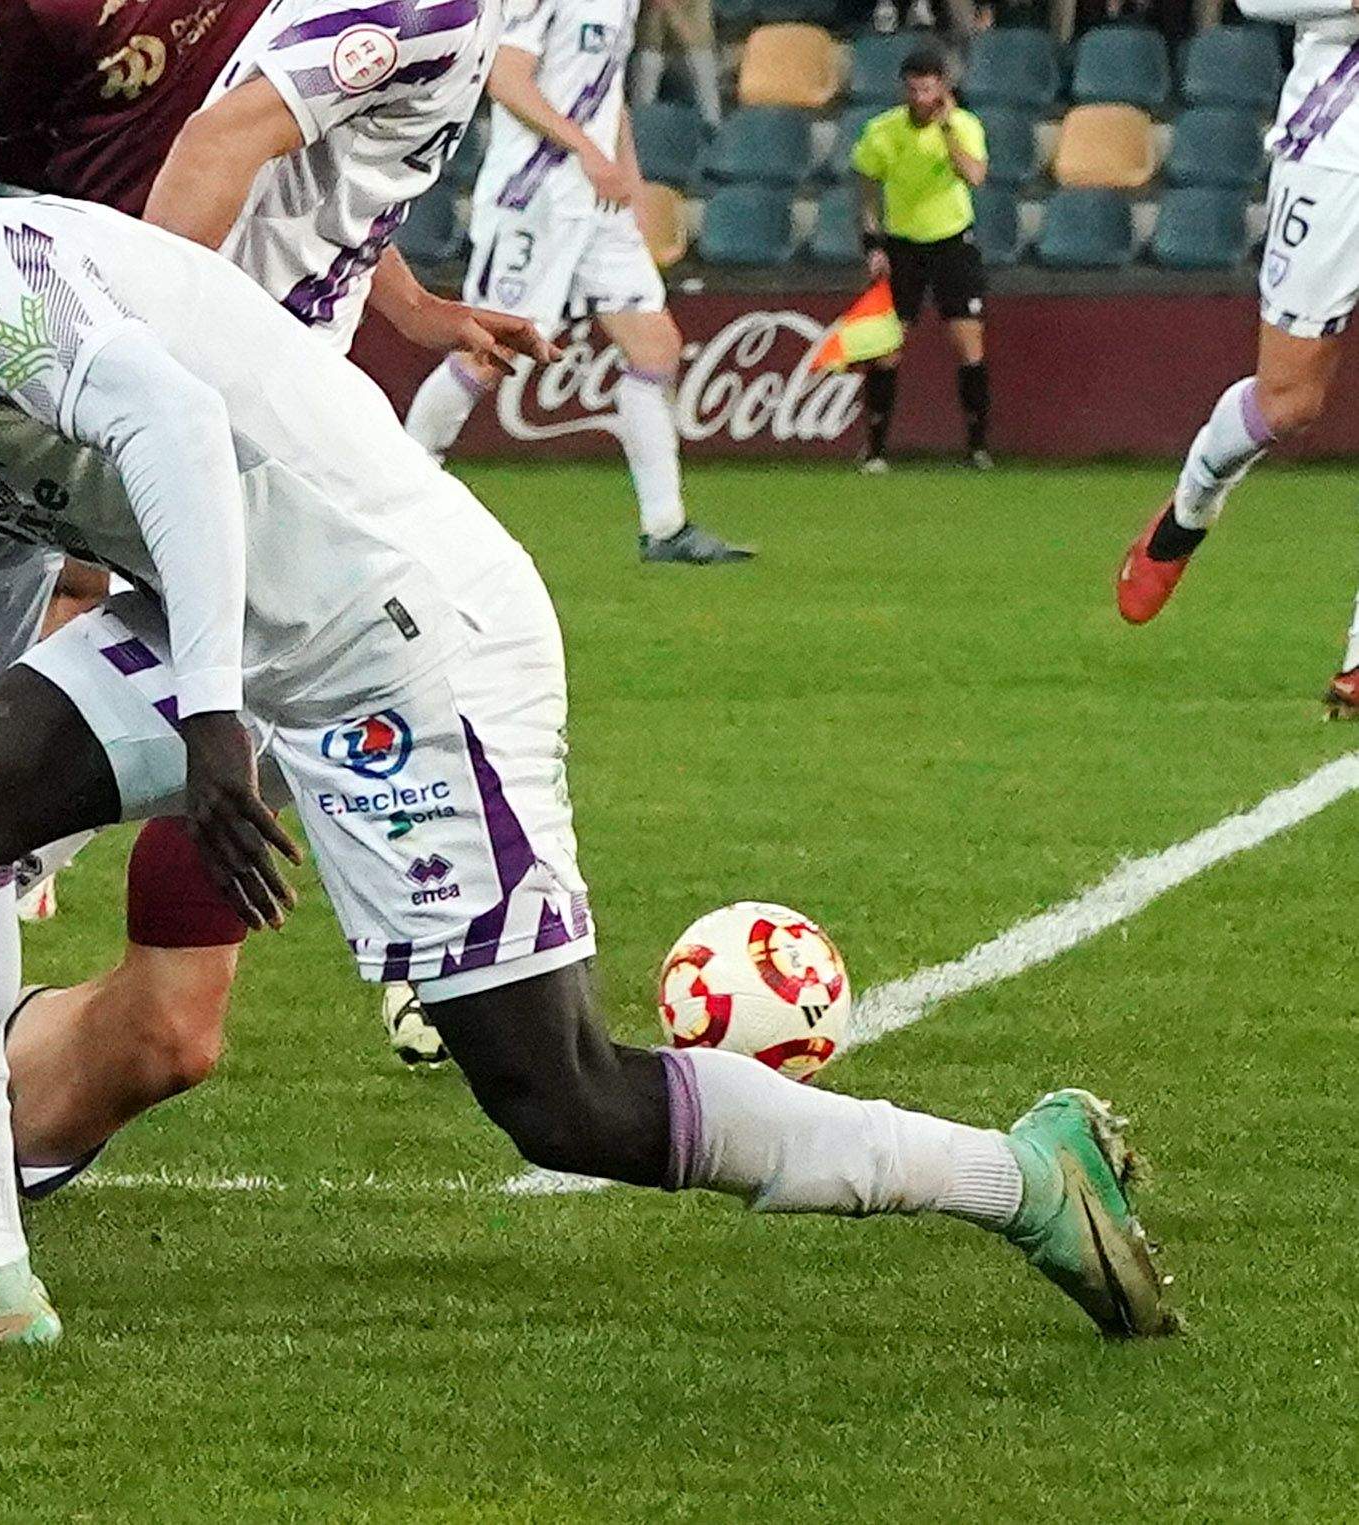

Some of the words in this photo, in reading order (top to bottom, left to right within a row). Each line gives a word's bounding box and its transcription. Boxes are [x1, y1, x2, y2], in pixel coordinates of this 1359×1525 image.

[1274, 186, 1317, 248] 16
[506, 228, 536, 272] 3
[318, 780, 451, 816] E.Leclerc
[386, 806, 456, 841] Soria
